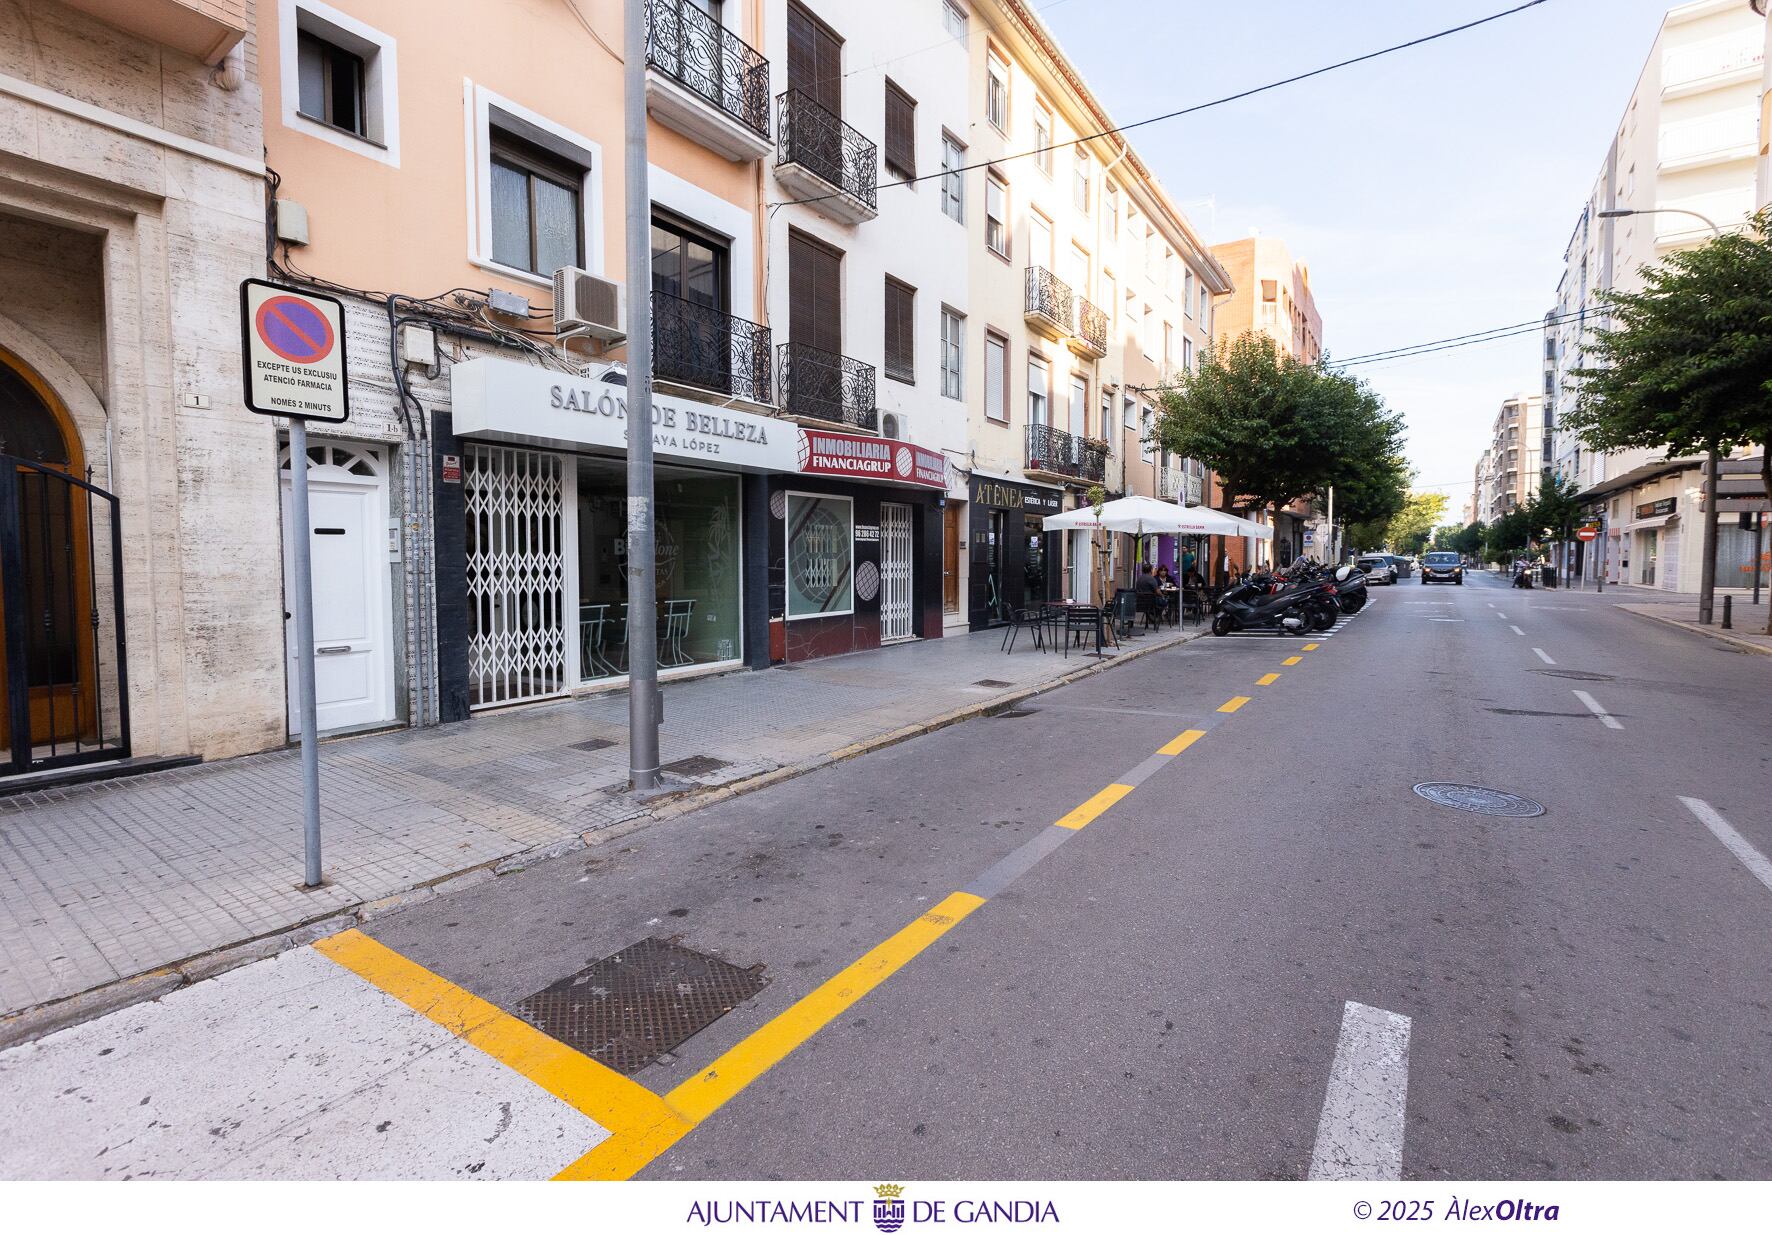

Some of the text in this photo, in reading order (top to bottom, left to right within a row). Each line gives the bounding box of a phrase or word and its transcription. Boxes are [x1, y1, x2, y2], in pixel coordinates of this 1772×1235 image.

[257, 360, 337, 380] EXCEPTE US EXCLUSIU
[263, 374, 332, 391] ATENCIÓ FARMACIA
[193, 396, 199, 405] 1
[304, 401, 331, 412] MINUTS
[686, 411, 768, 445] BELLEZA
[683, 438, 720, 454] LÓPEZ
[812, 436, 891, 461] INMOBILIARIA
[813, 456, 891, 473] FINANCIAGRUP
